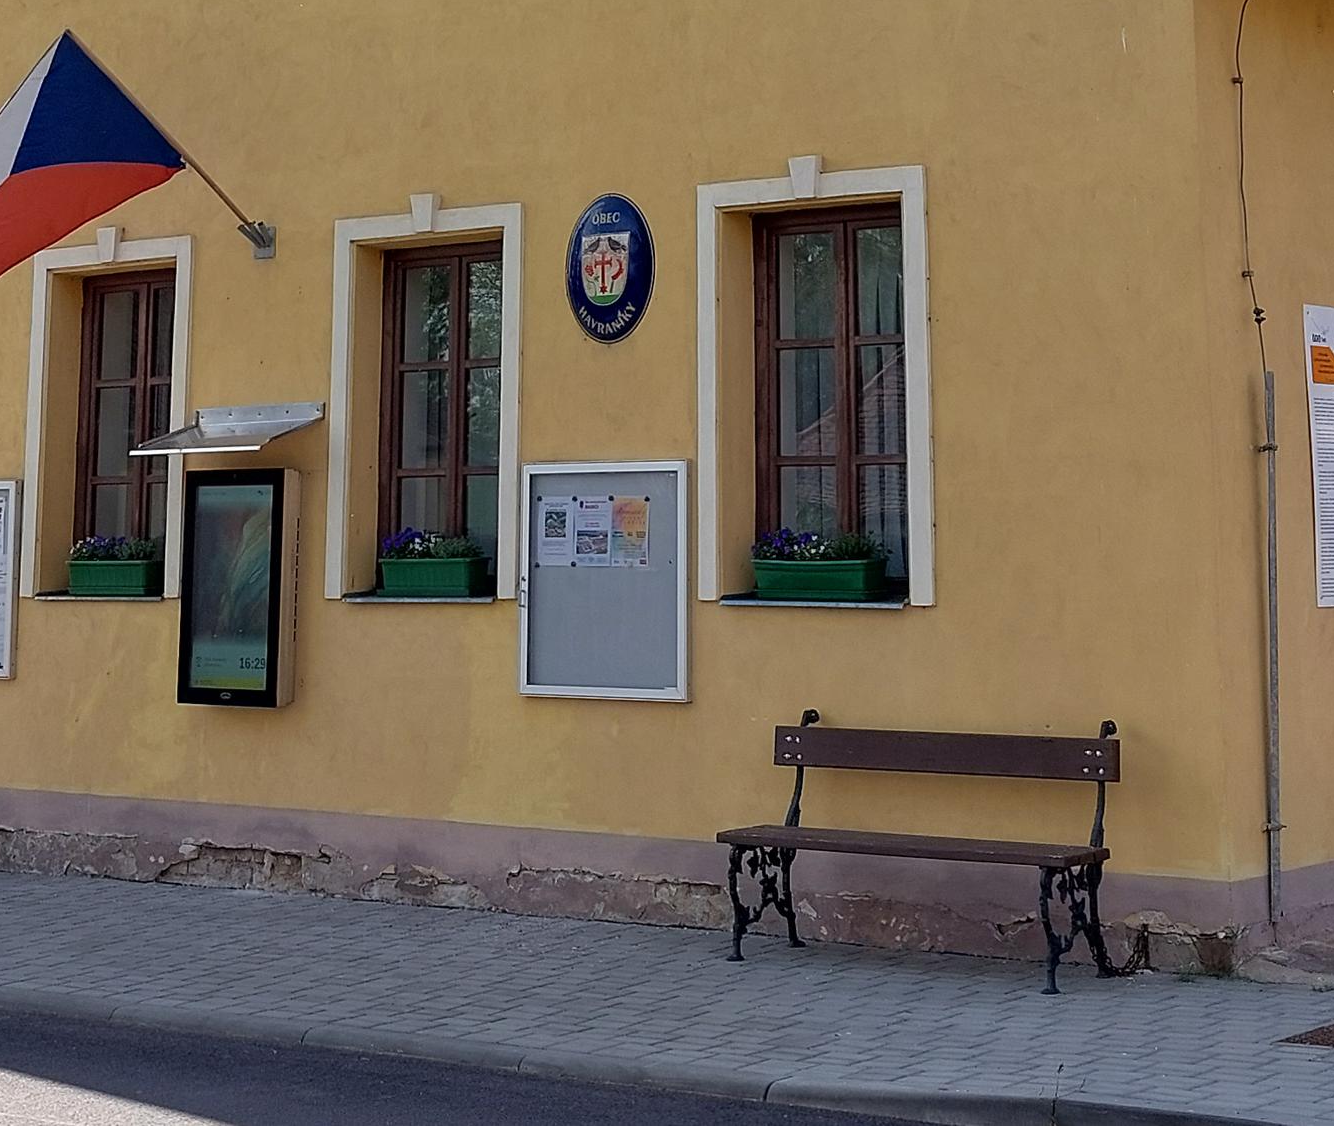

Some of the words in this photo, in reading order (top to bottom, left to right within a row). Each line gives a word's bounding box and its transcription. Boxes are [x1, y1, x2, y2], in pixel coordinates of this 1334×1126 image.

[592, 212, 621, 224] OBEC
[579, 301, 636, 335] HAVRANÍKY
[239, 657, 266, 670] 16:29
